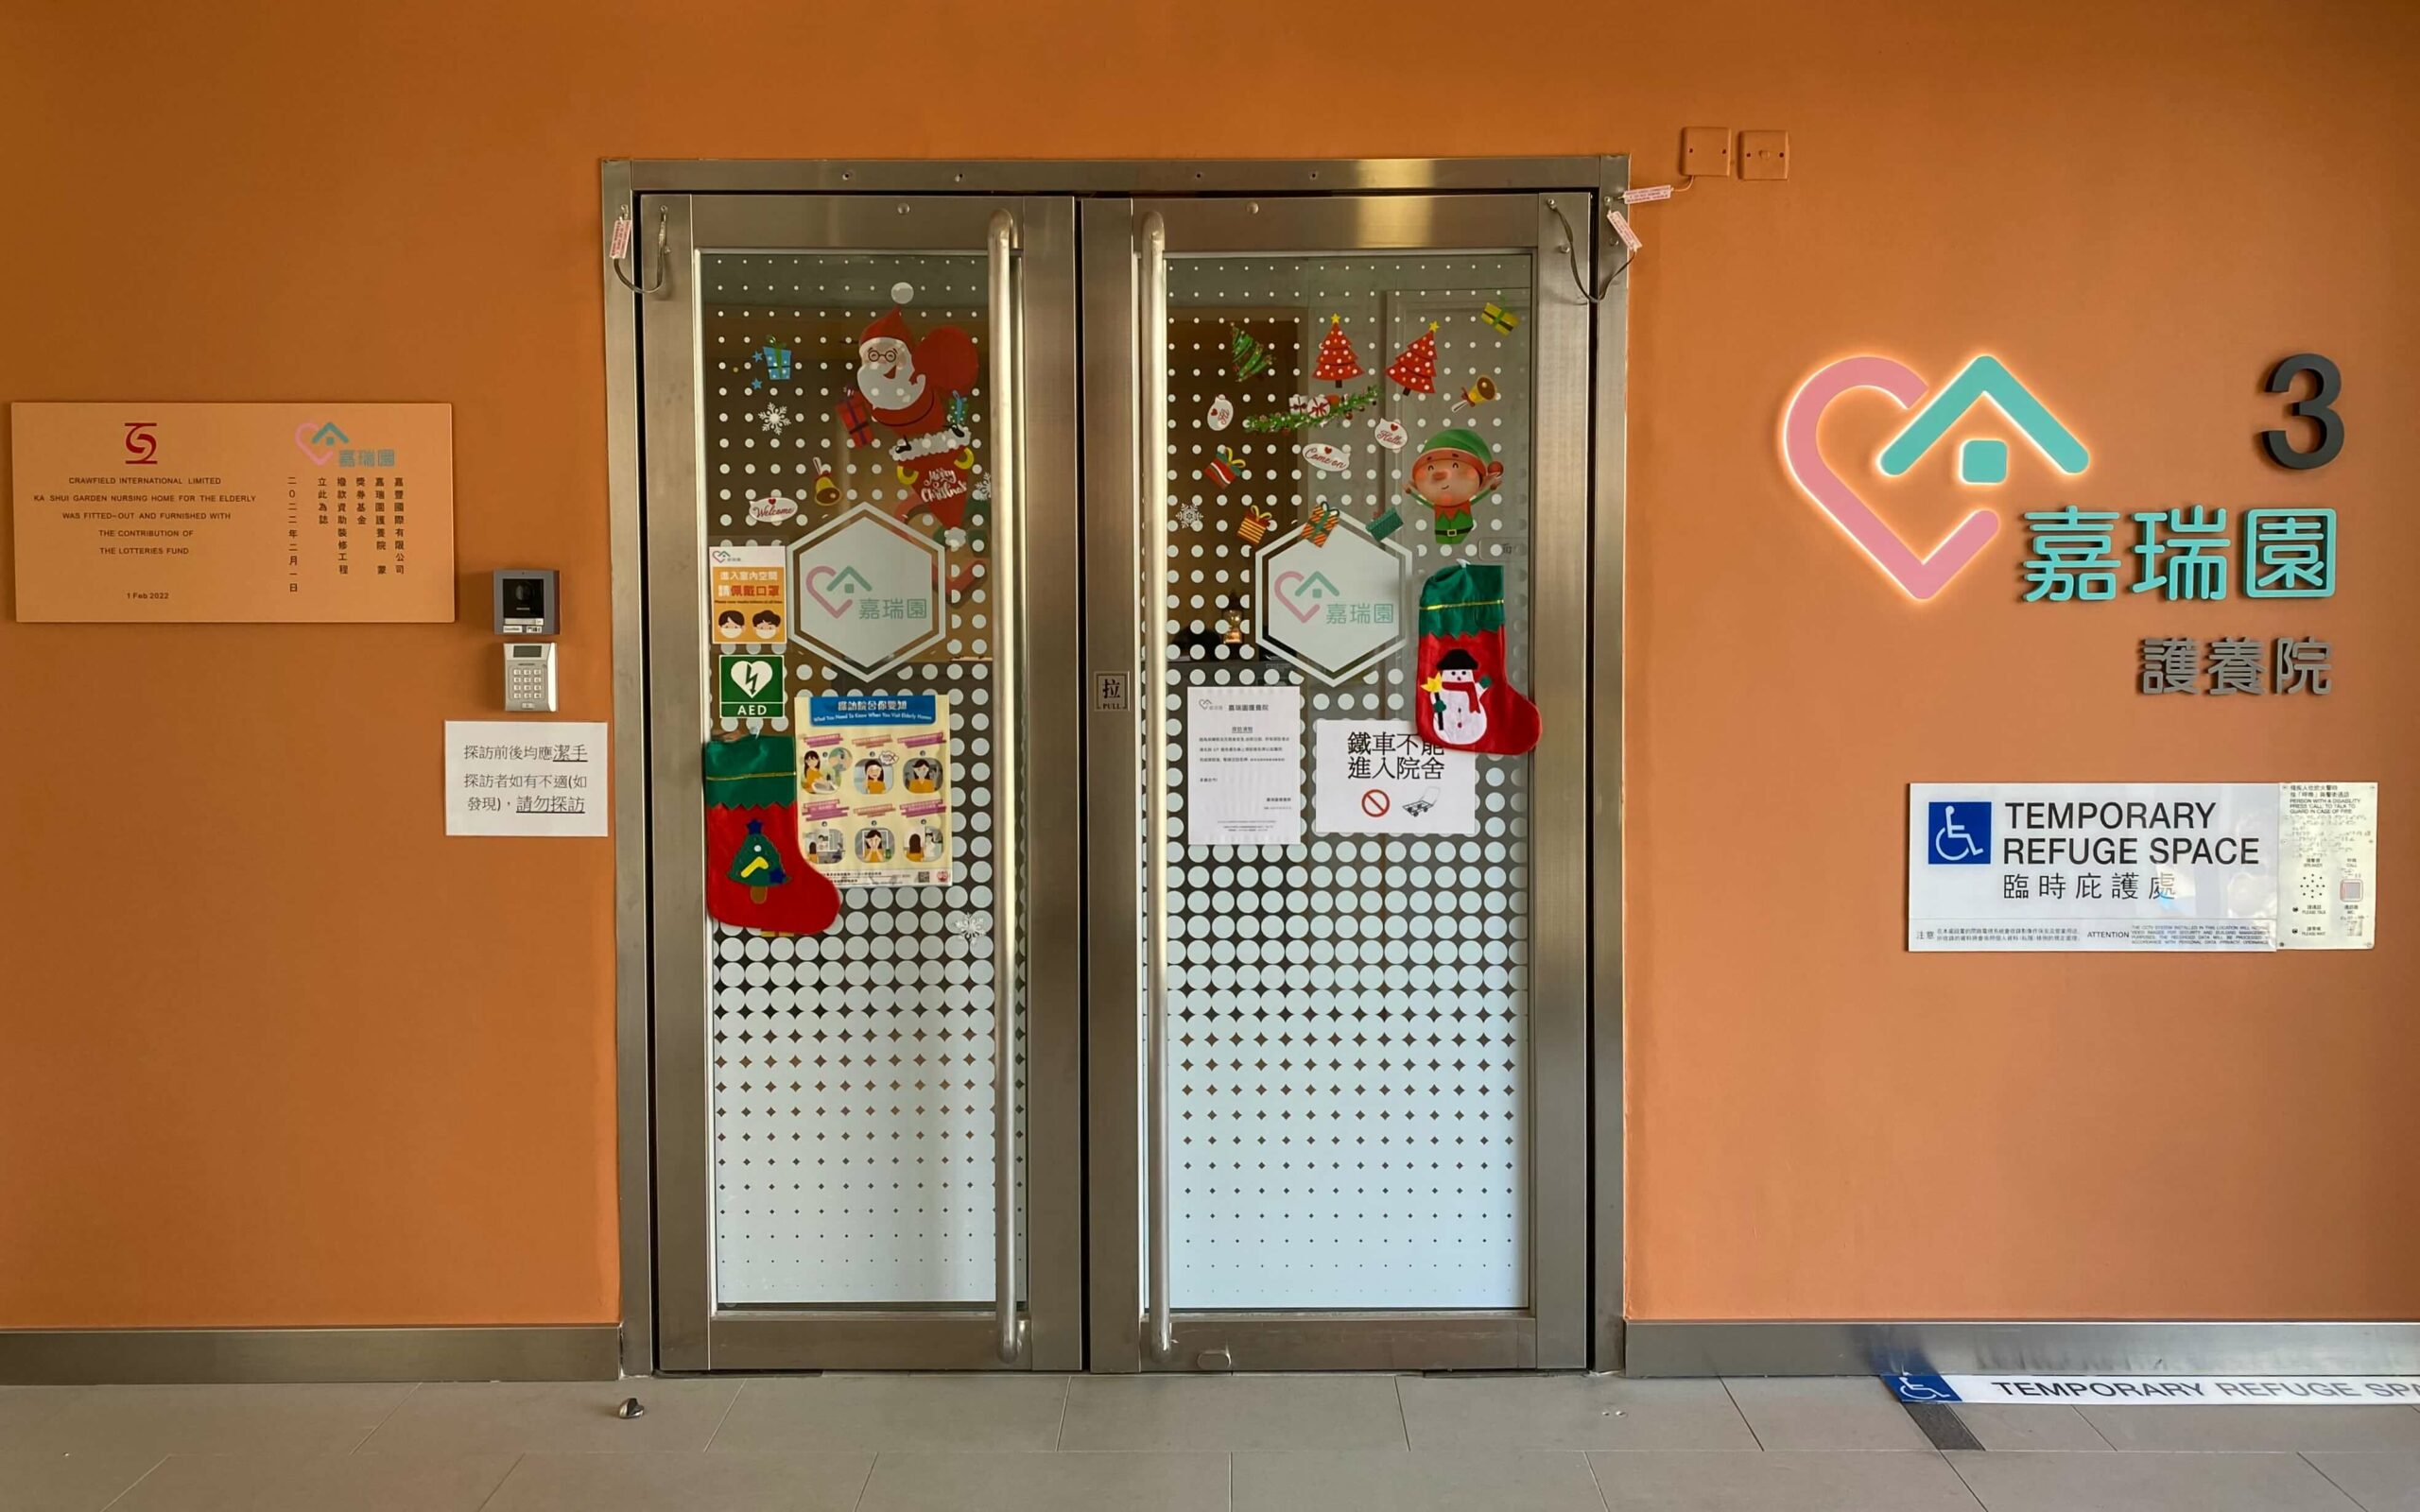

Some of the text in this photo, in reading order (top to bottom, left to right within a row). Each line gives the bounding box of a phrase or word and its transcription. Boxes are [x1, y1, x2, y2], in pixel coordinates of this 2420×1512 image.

[2258, 352, 2345, 471] 3
[1377, 430, 1404, 446] Hello
[1305, 448, 1347, 469] Come on
[68, 476, 116, 485] CRAWFIELD
[119, 476, 182, 485] INTERNATIONAL
[923, 468, 956, 486] Merry
[920, 480, 967, 502] Christmas
[752, 504, 796, 518] Welcome
[2021, 505, 2337, 603] 嘉瑞園
[127, 592, 130, 600] 1
[859, 597, 927, 619] 嘉瑞園
[1326, 603, 1393, 625] 嘉瑞園
[2138, 636, 2333, 696] 護養院
[1102, 679, 1120, 698] 拉
[737, 704, 768, 715] AED
[463, 744, 588, 761] 探訪前後均應潔手
[1347, 756, 1445, 780] 進入院舍
[2004, 801, 2217, 829] TEMPORARY
[2003, 837, 2259, 865] REFUGE SPACE
[2003, 872, 2176, 900] 臨時庇護處
[1916, 930, 1934, 939] 注意
[1990, 1382, 2206, 1397] TEMPORARY
[2213, 1382, 2363, 1398] REFUGE
